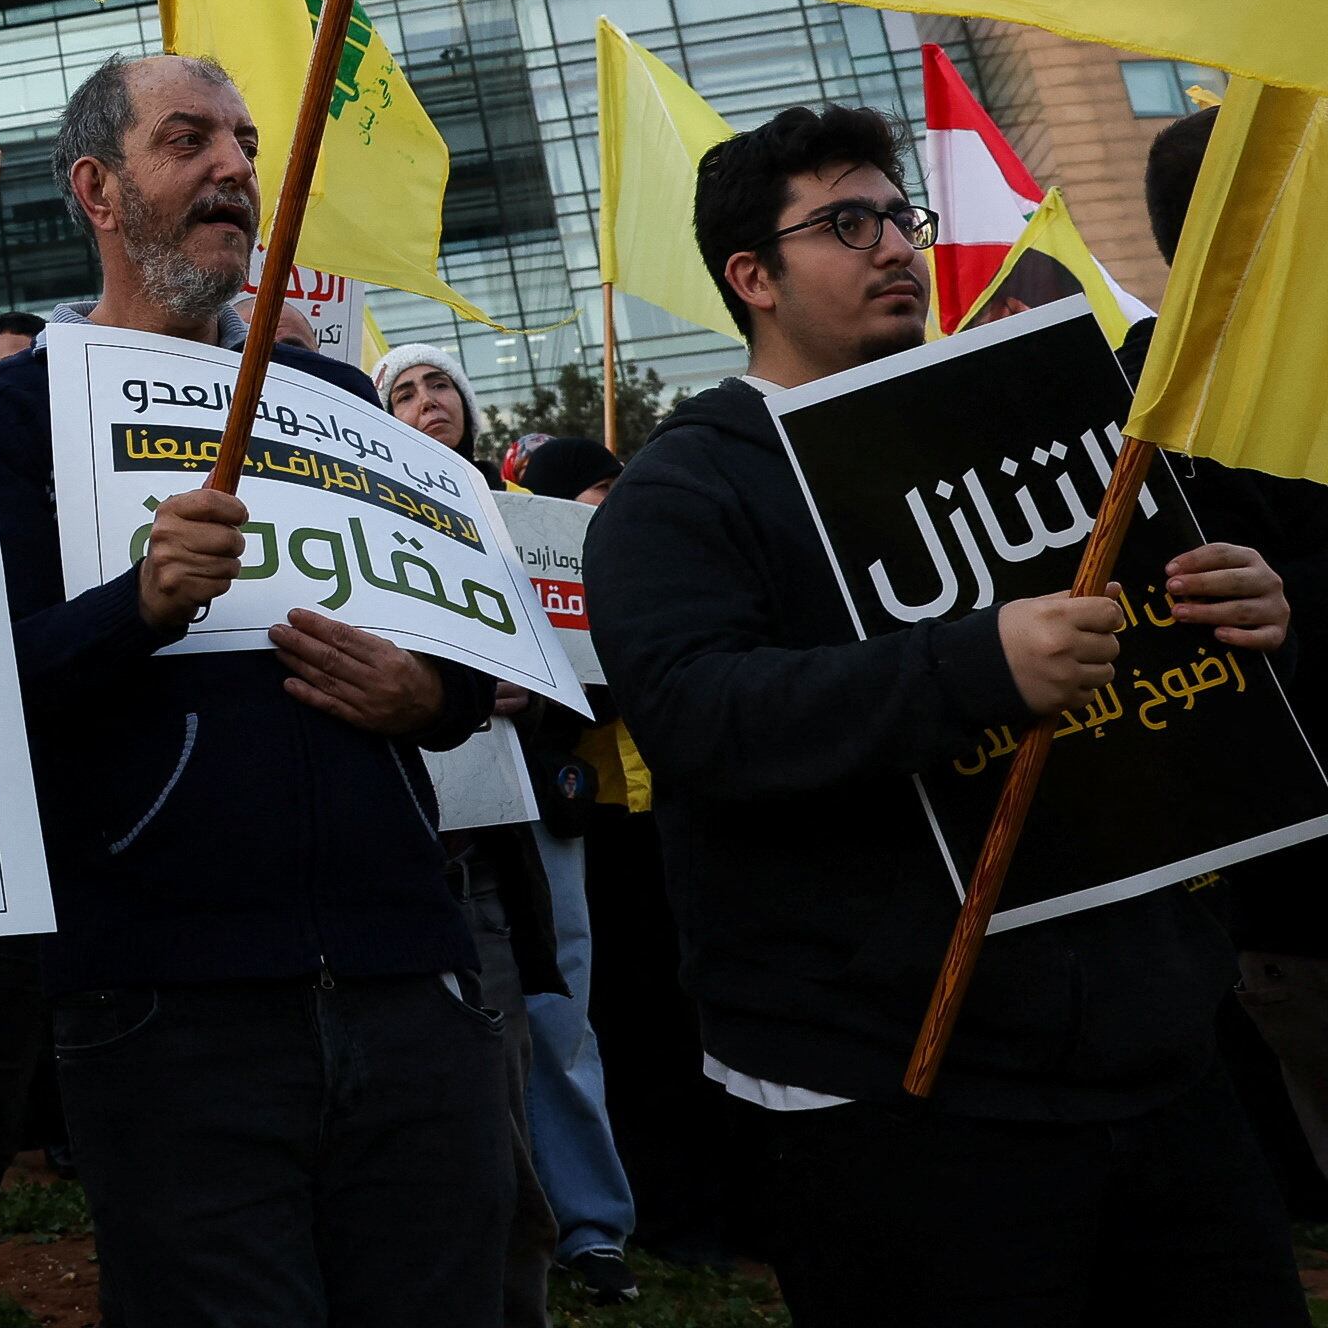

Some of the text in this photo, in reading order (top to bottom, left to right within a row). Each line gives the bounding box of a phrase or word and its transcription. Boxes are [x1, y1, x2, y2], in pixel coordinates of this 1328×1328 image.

[122, 379, 232, 414] العدو
[403, 461, 461, 499] في
[377, 482, 456, 539] يوجد
[458, 516, 480, 544] لا
[527, 545, 551, 572] أراد
[1133, 647, 1246, 731] رضوخ
